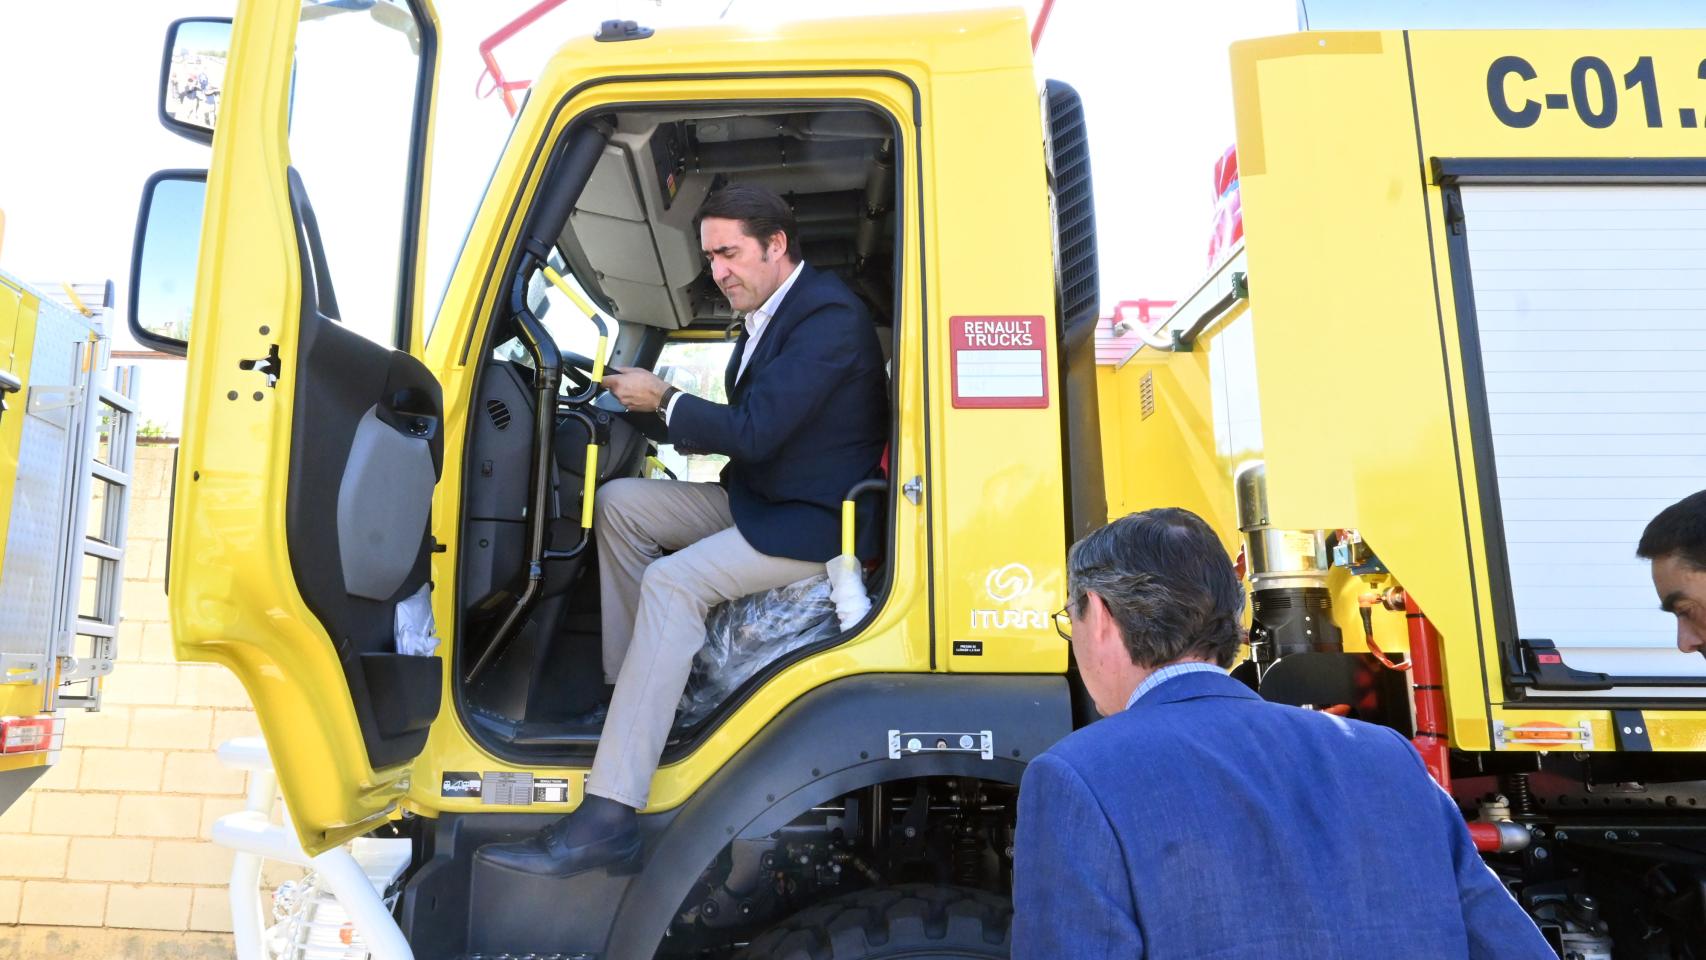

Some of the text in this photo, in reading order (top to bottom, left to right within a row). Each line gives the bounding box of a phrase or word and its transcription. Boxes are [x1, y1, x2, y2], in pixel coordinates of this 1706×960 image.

[1486, 55, 1706, 129] C-01.
[964, 321, 1032, 334] RENAULT
[964, 333, 1033, 346] TRUCKS
[970, 608, 1049, 630] ITURRI
